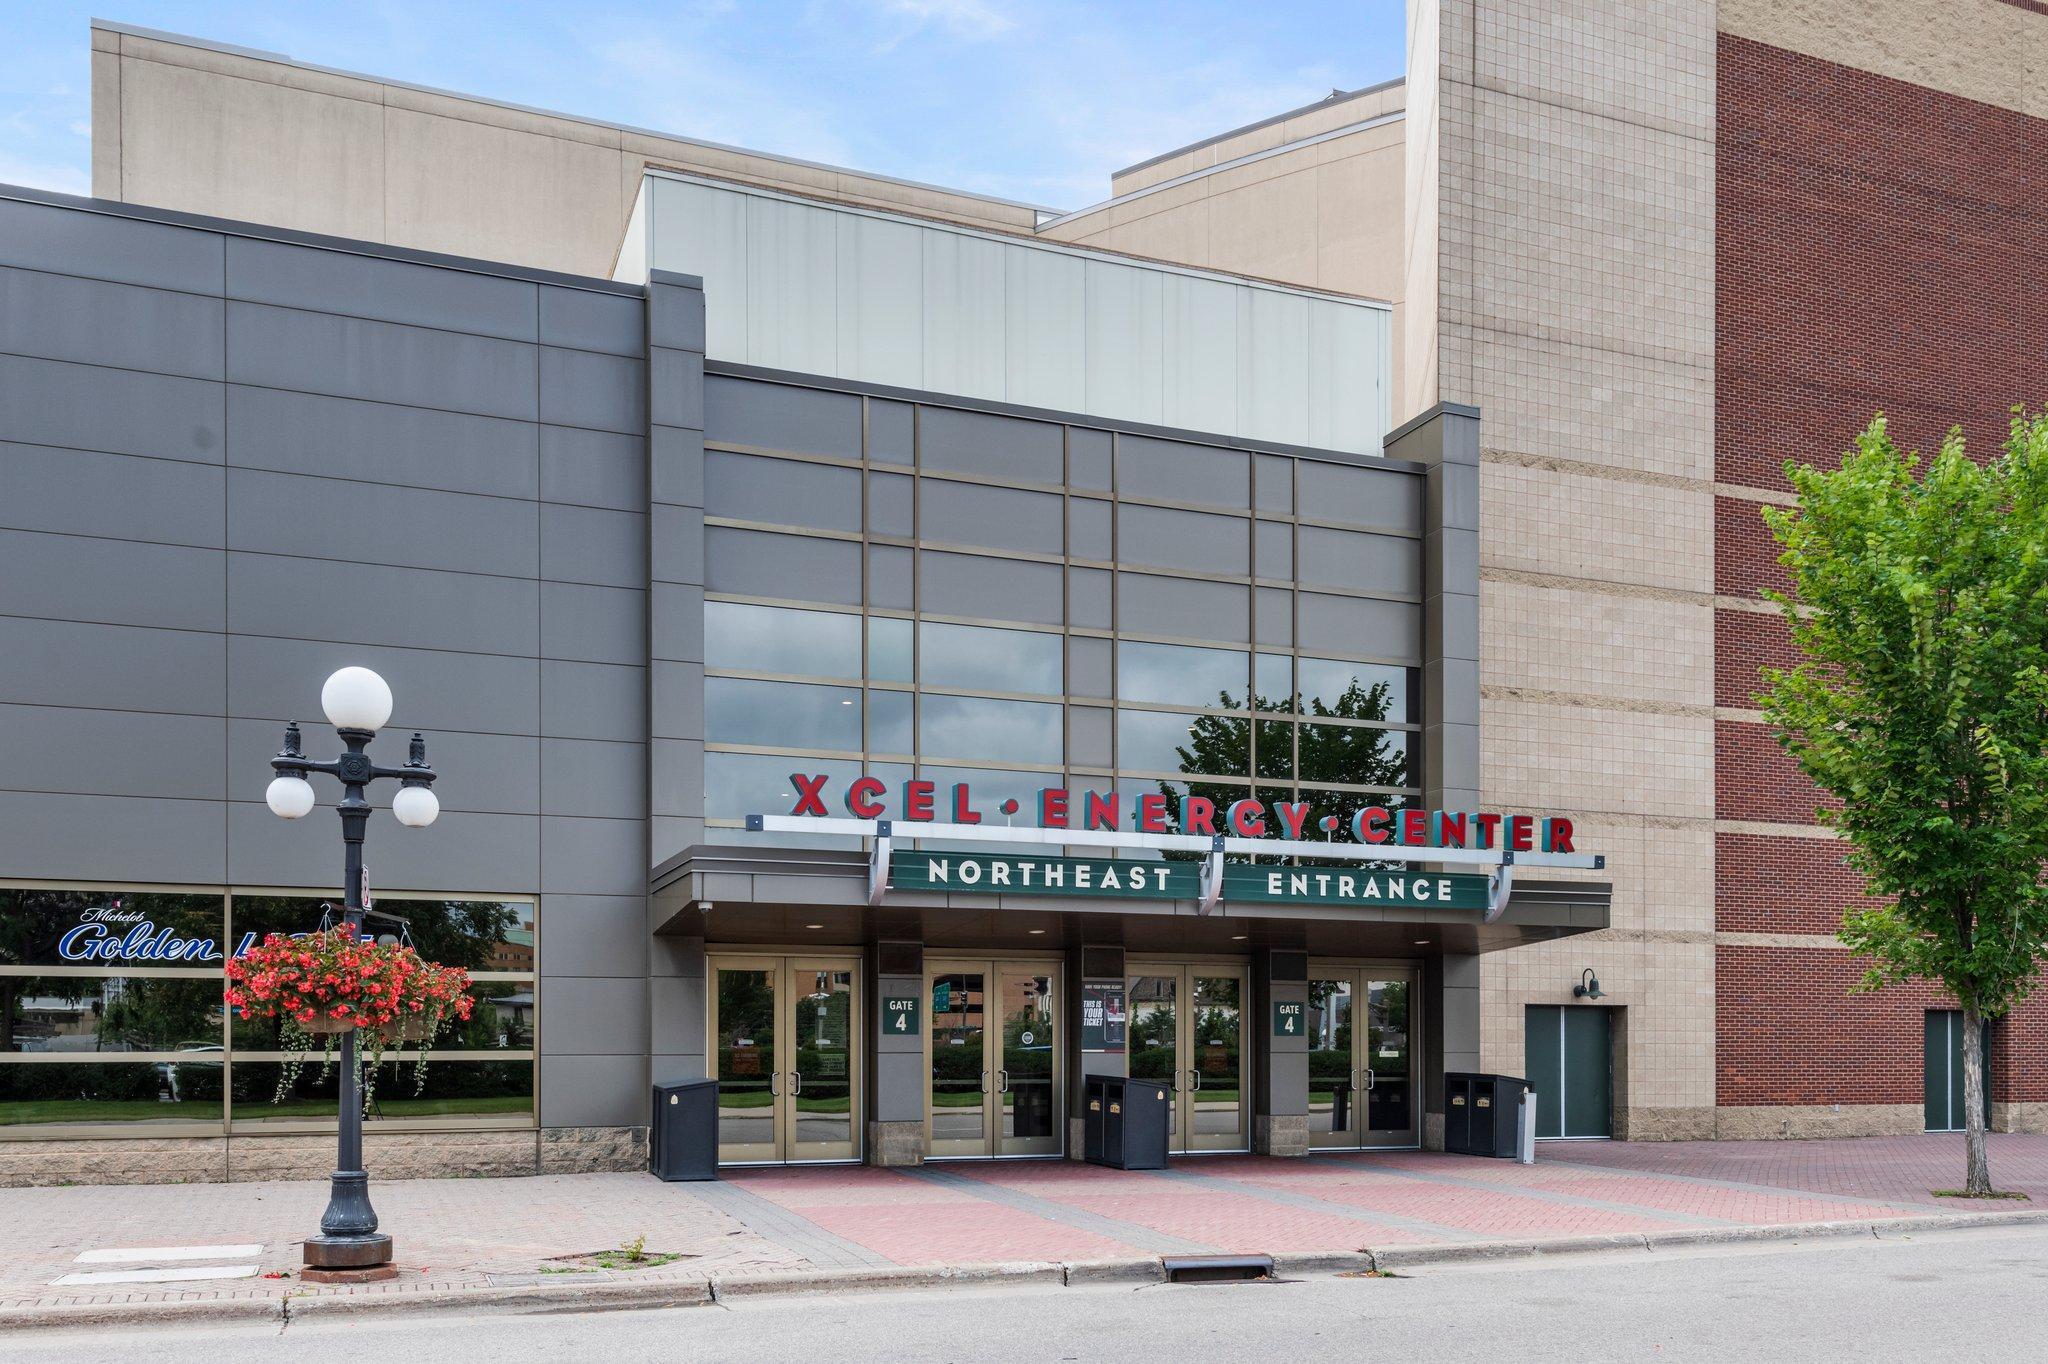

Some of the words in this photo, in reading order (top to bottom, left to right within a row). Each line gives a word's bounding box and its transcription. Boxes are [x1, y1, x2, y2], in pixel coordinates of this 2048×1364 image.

[789, 773, 981, 826] XCEL
[1037, 788, 1310, 840] ENERGY
[1352, 806, 1575, 853] CENTER
[929, 858, 1171, 891] NORTHEAST
[1267, 872, 1452, 901] ENTRANCE
[80, 908, 147, 923] Michelob
[58, 921, 224, 961] Golden
[890, 1000, 913, 1011] GATE
[1083, 1000, 1095, 1008] THIS
[1096, 1000, 1102, 1008] IS
[1280, 1005, 1300, 1014] GATE
[1084, 1008, 1103, 1018] YOUR
[895, 1013, 907, 1031] 4
[1083, 1018, 1103, 1026] TICKET
[1284, 1016, 1295, 1033] 4
